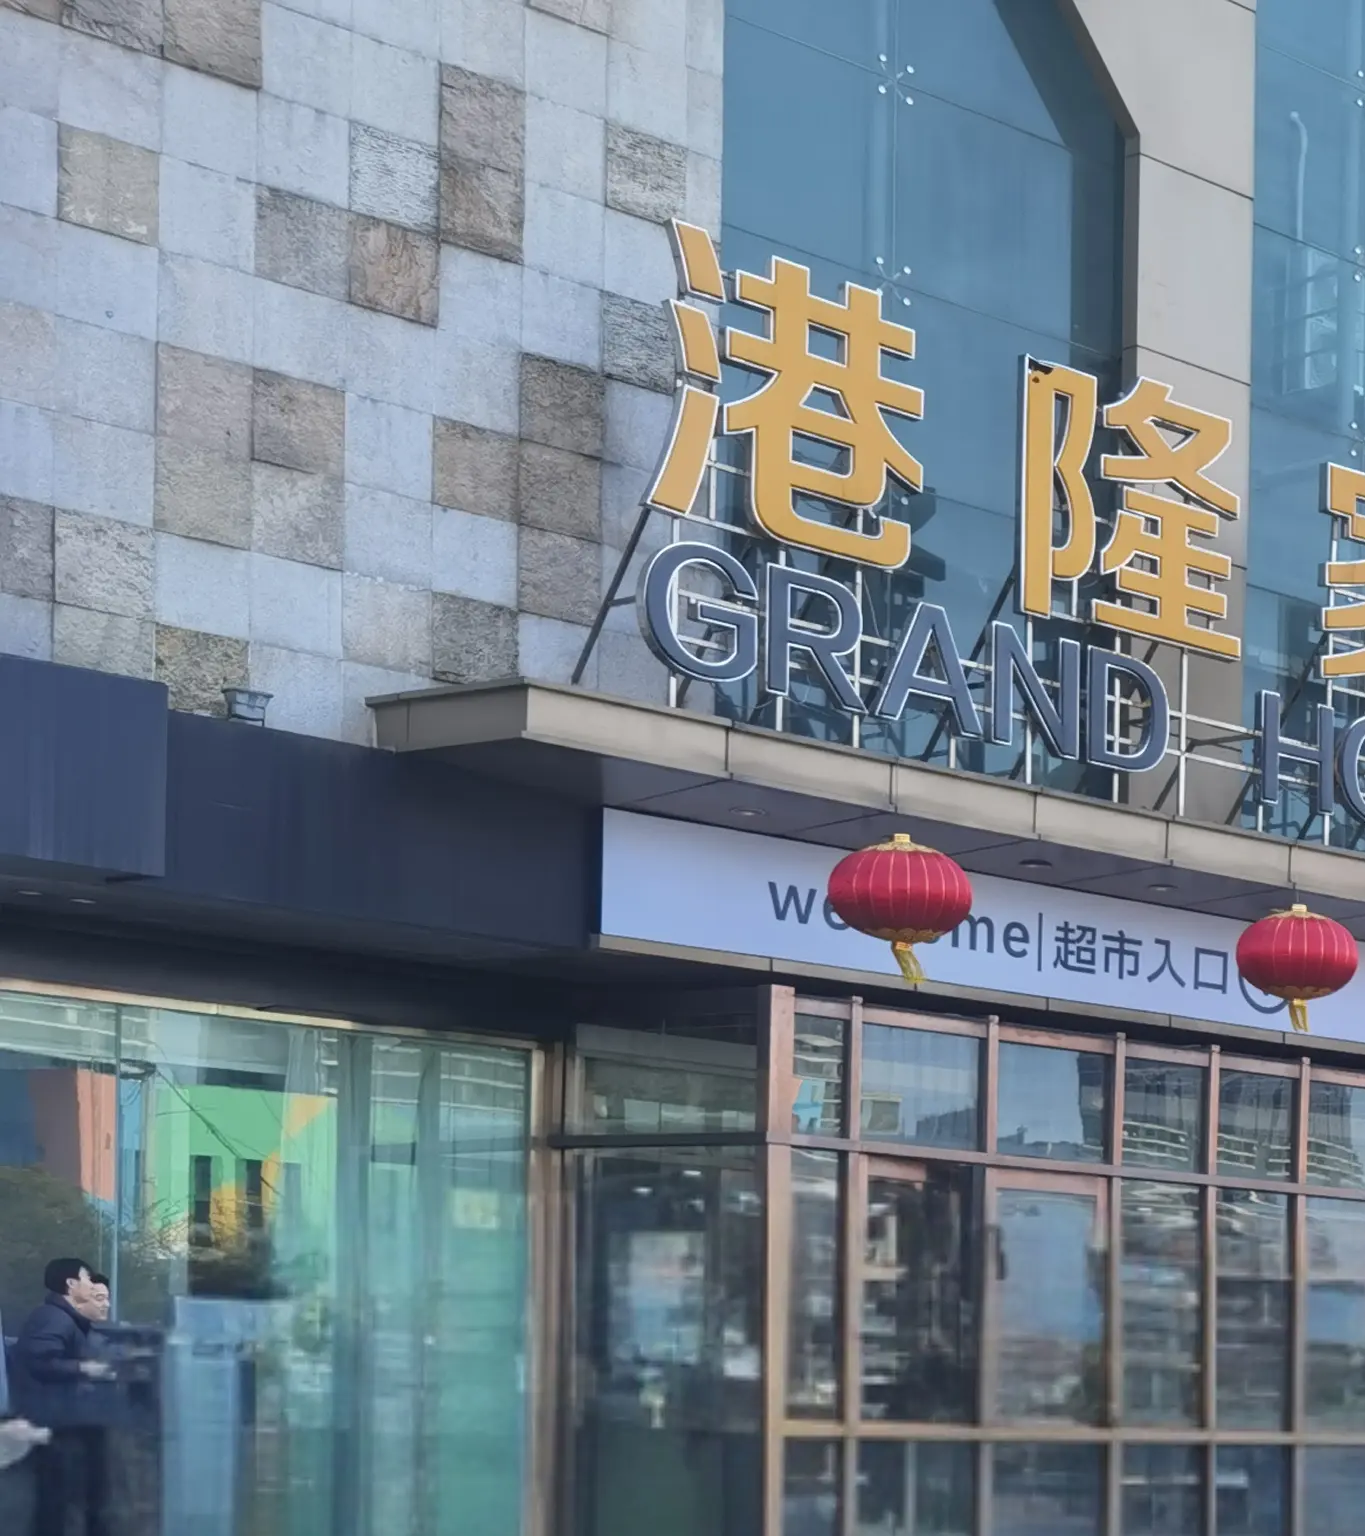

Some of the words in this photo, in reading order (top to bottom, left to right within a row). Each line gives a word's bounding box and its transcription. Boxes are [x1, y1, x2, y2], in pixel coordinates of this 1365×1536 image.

[638, 541, 1170, 774] GRAND
[1053, 920, 1229, 994] 超市入口
